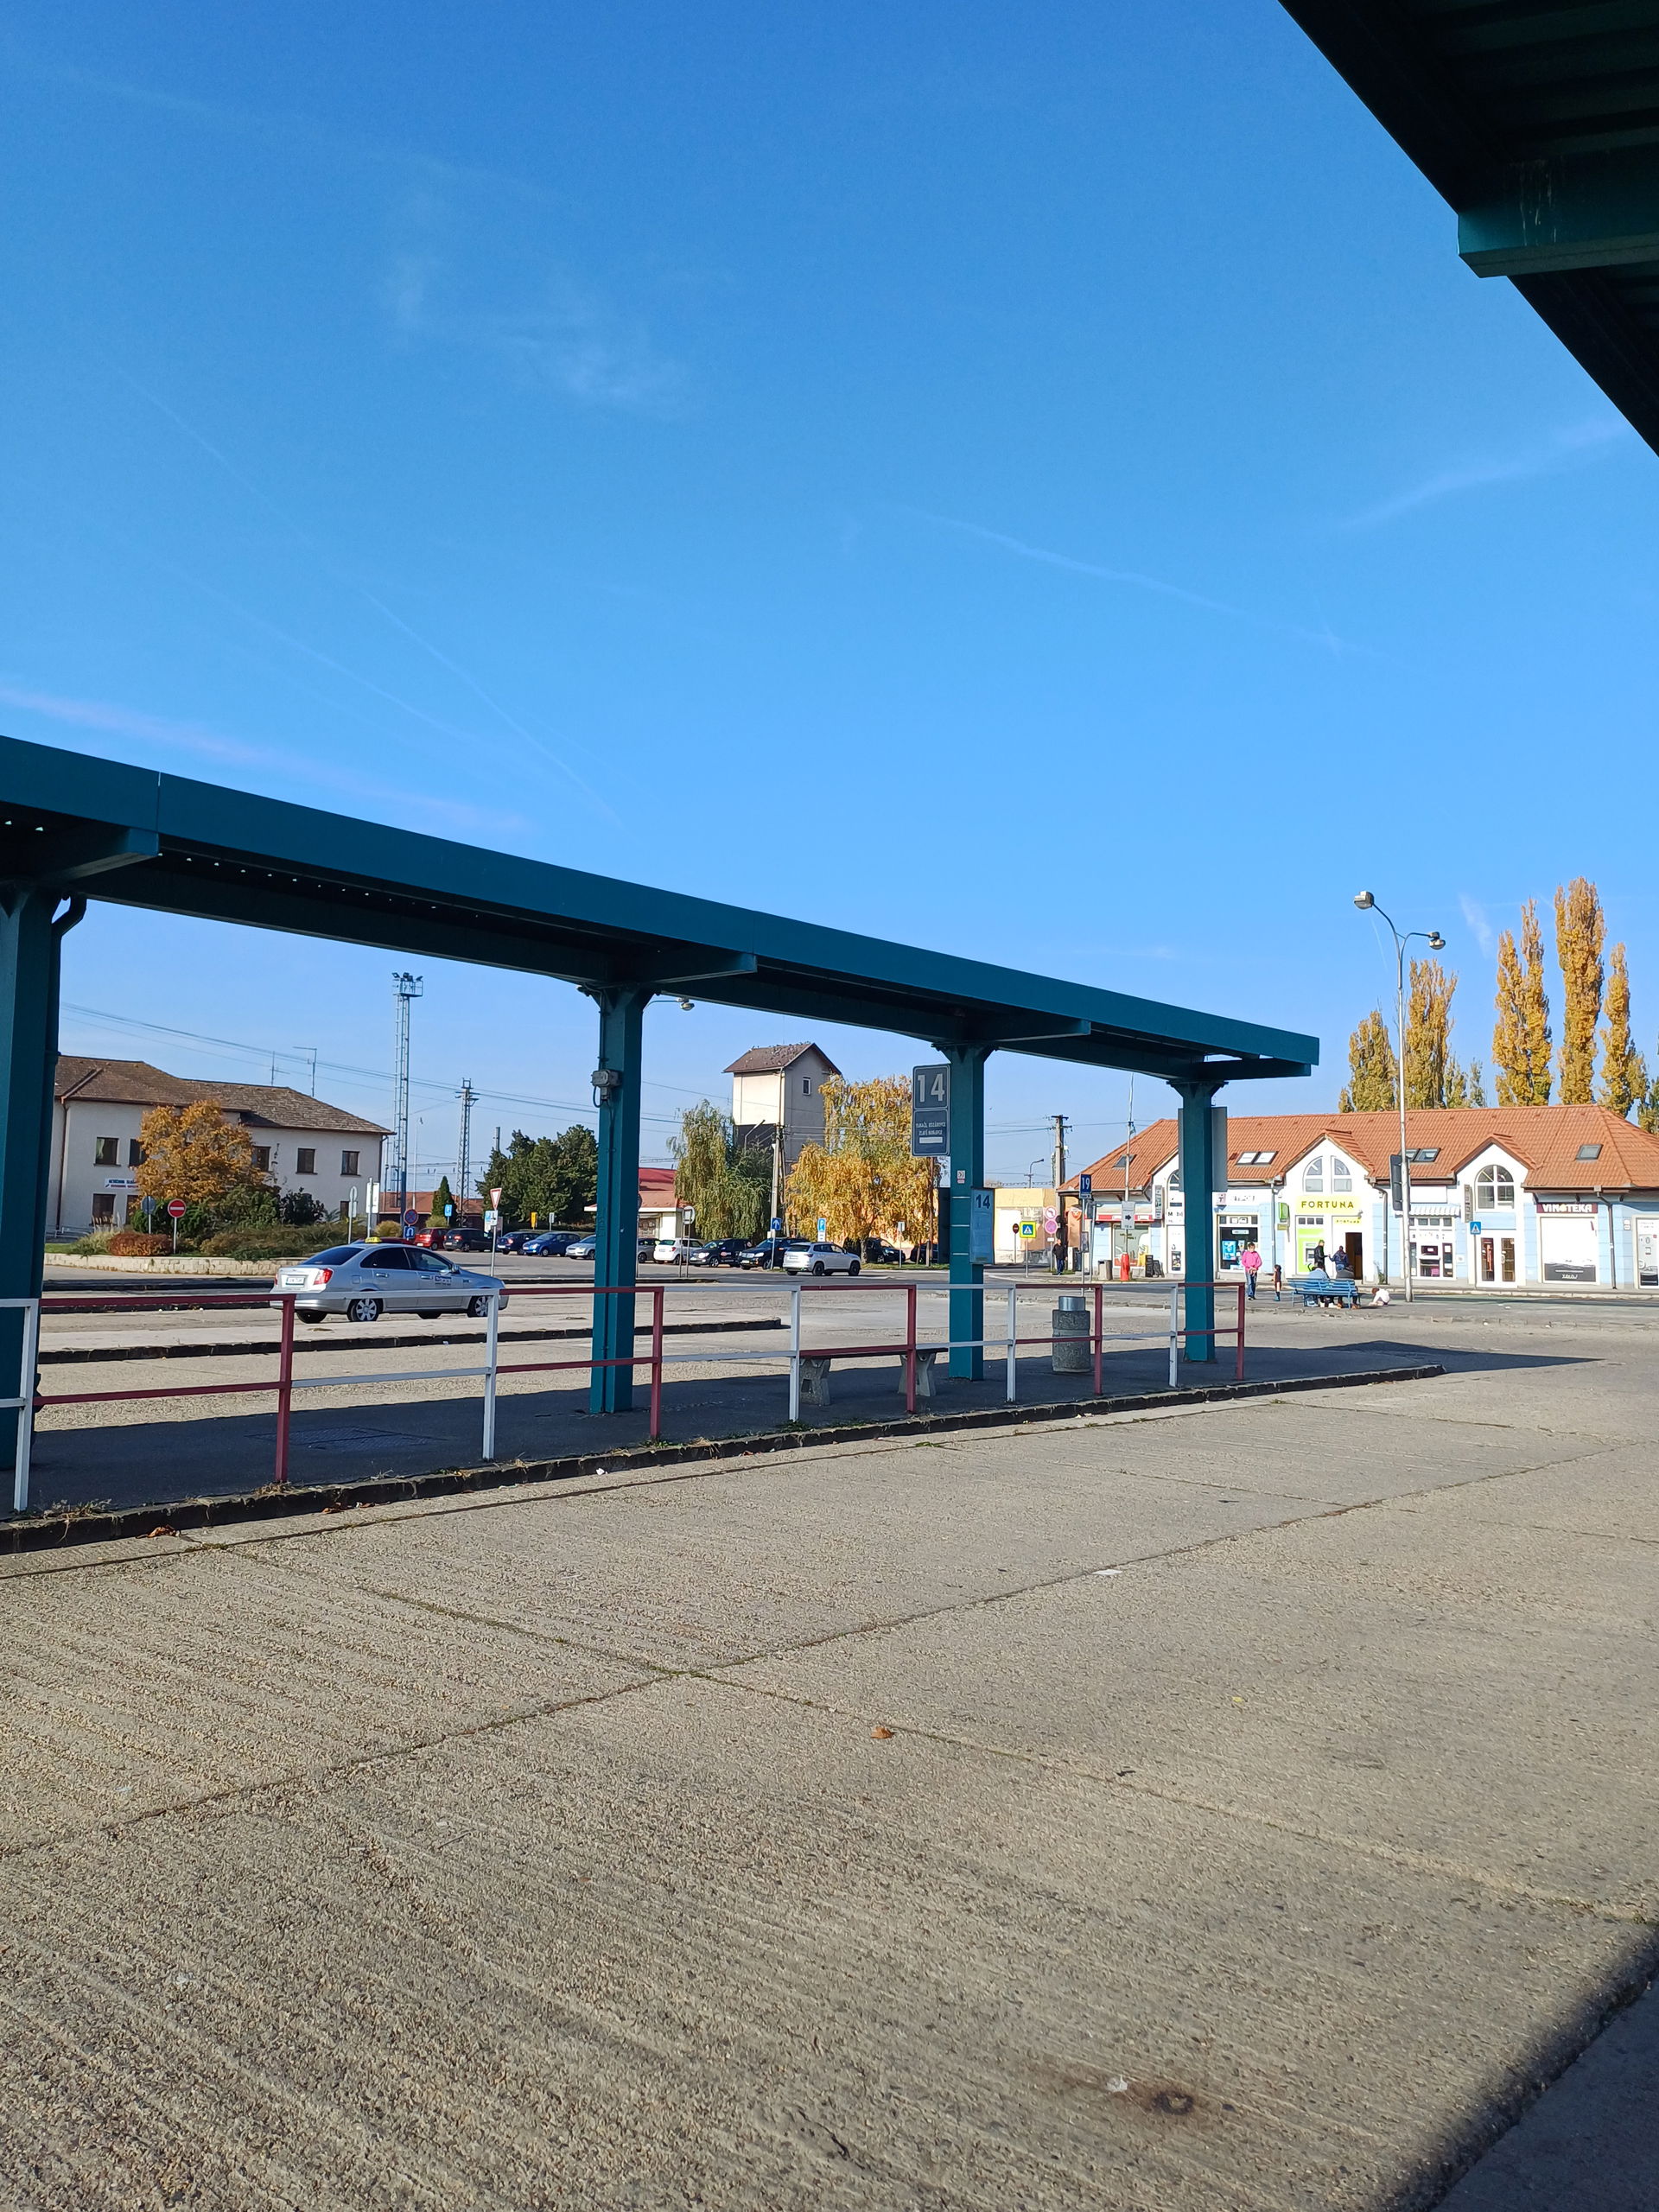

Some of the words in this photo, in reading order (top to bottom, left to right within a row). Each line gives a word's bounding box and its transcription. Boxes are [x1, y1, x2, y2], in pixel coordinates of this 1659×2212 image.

[918, 1073, 945, 1103] 14
[1082, 1177, 1090, 1189] 19
[976, 1194, 991, 1209] 14
